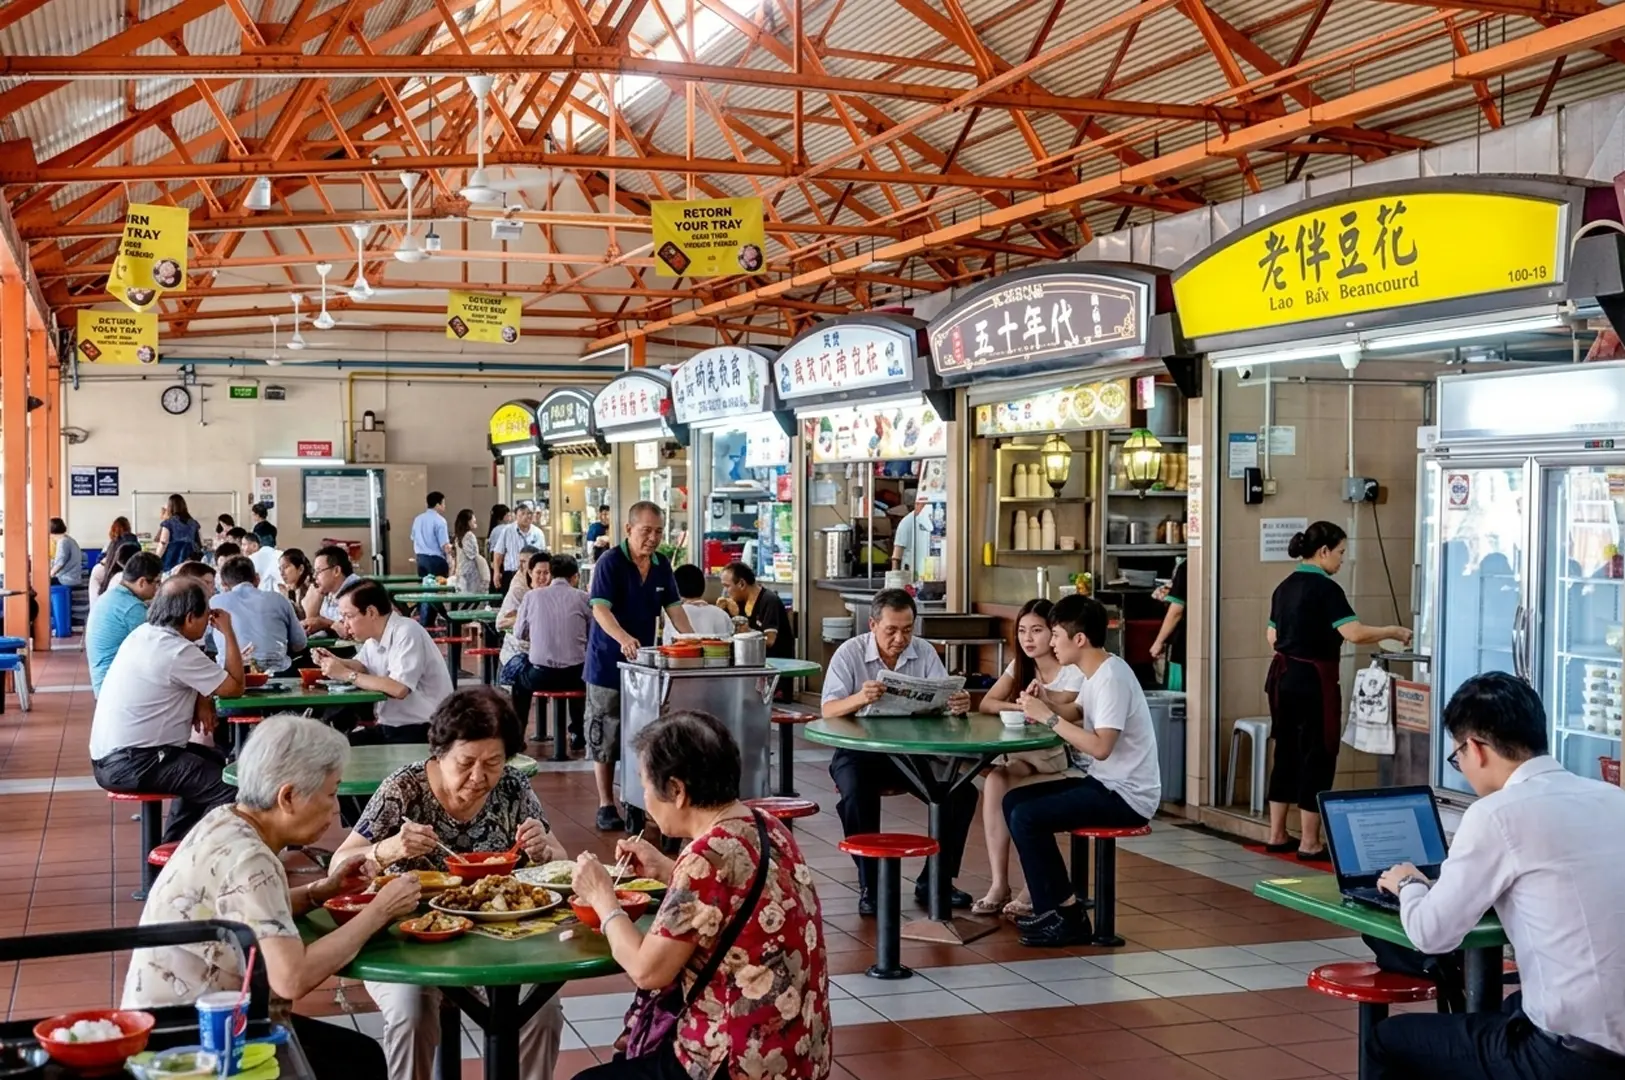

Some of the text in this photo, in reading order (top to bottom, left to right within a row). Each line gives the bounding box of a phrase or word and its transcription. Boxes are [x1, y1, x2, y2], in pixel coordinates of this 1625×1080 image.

[127, 227, 161, 240] TRAY
[674, 219, 743, 231] YOUR TRAY
[1258, 200, 1418, 292] 老伴豆花
[1269, 297, 1293, 311] Lao
[1339, 270, 1419, 299] Beancourd
[974, 298, 1077, 357] 五十年代
